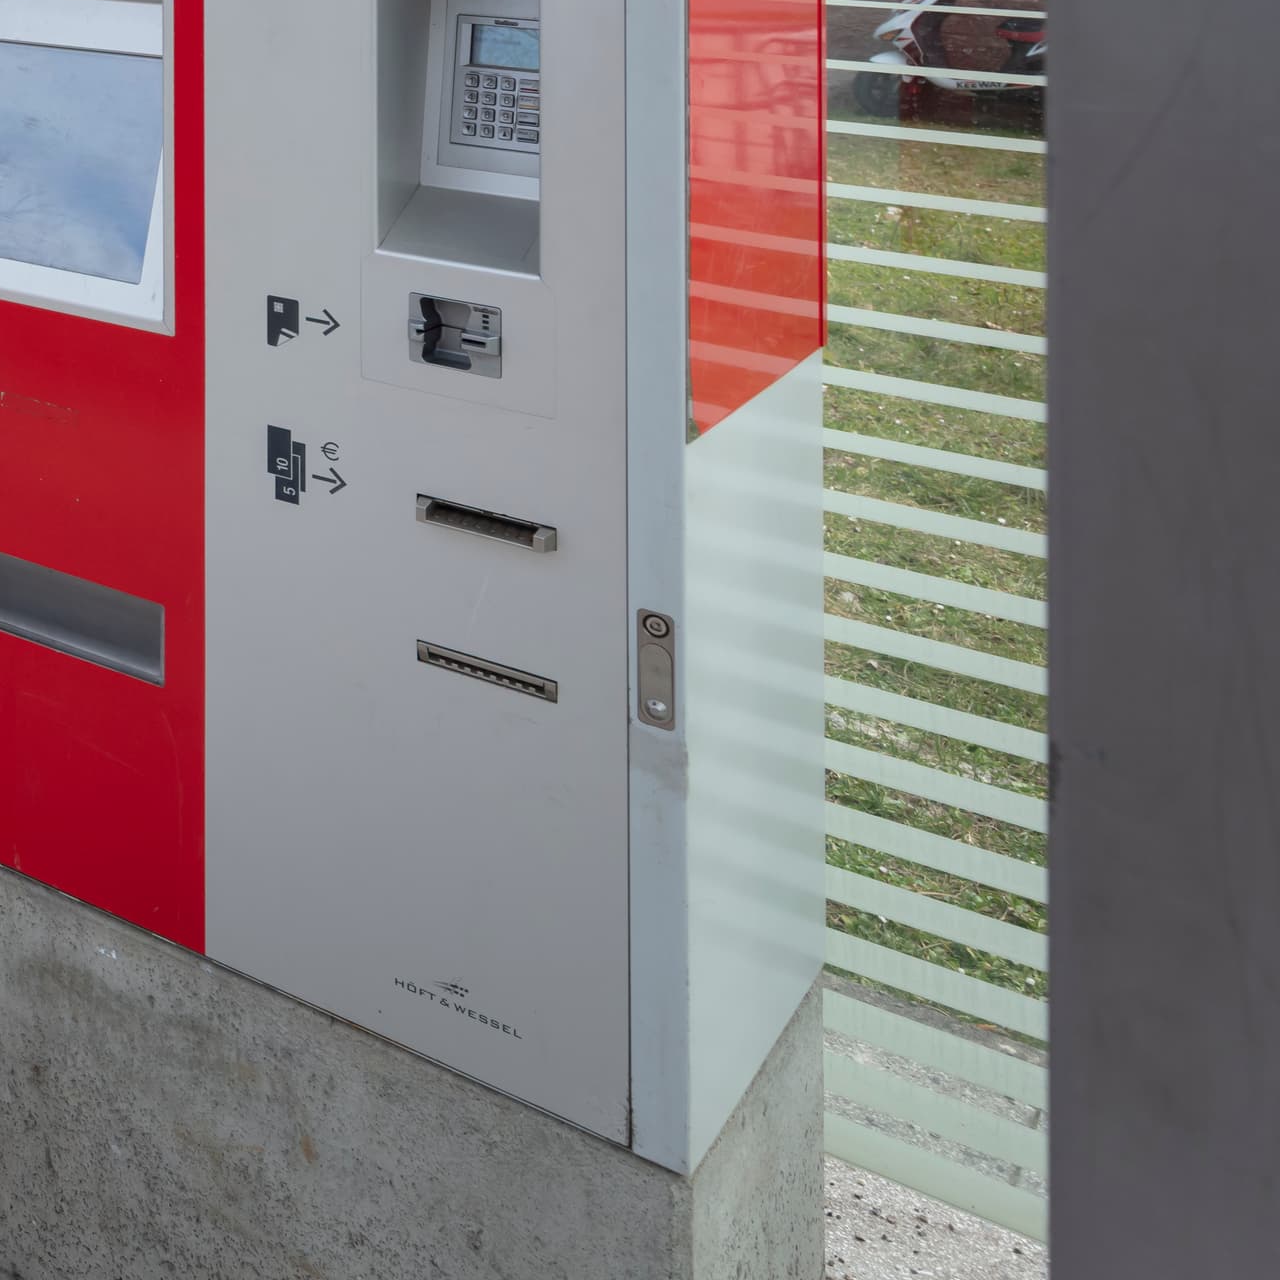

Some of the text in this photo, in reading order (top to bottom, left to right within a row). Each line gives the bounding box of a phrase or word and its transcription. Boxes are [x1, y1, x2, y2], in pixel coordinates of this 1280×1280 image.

[275, 457, 289, 470] 10
[282, 486, 296, 496] 5
[439, 998, 450, 1009] &
[453, 1002, 524, 1040] WESSEL
